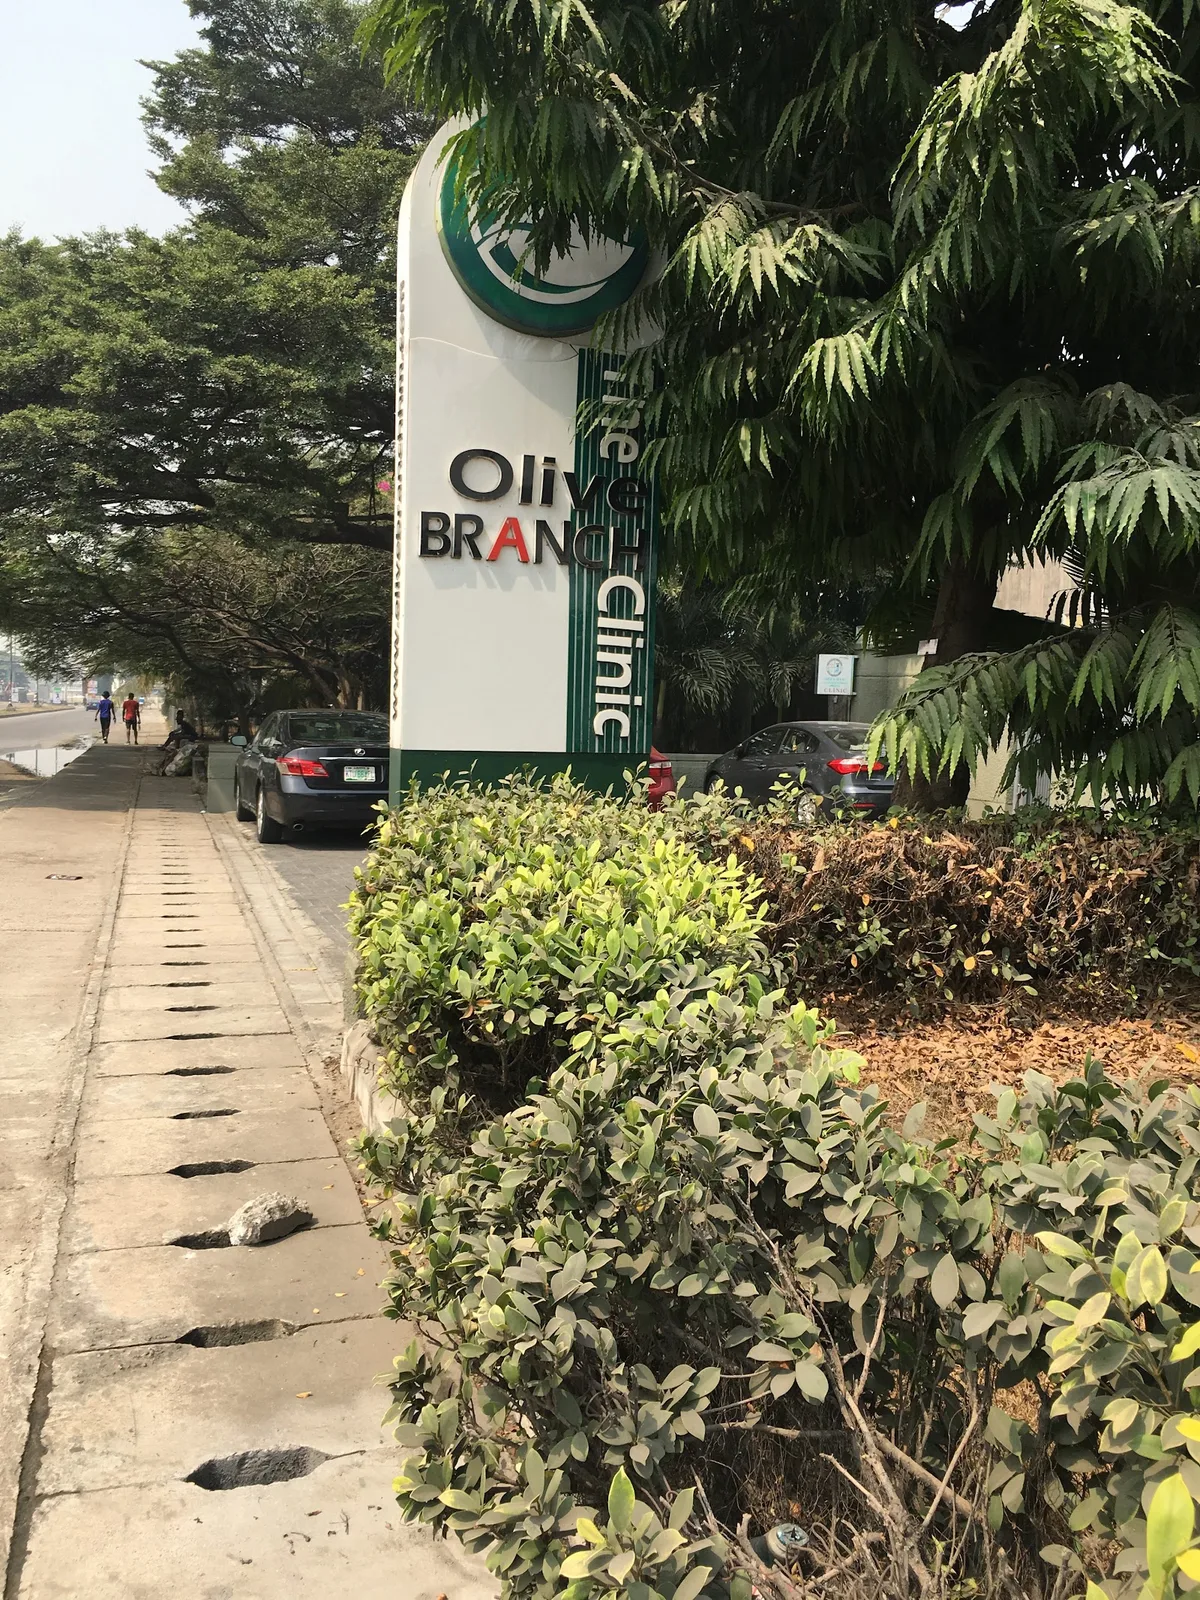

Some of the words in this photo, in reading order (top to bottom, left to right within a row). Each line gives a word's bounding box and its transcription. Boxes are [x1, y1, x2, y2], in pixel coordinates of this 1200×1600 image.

[450, 448, 647, 516] Olive
[418, 510, 646, 572] BRANCH
[593, 575, 645, 738] Clinic
